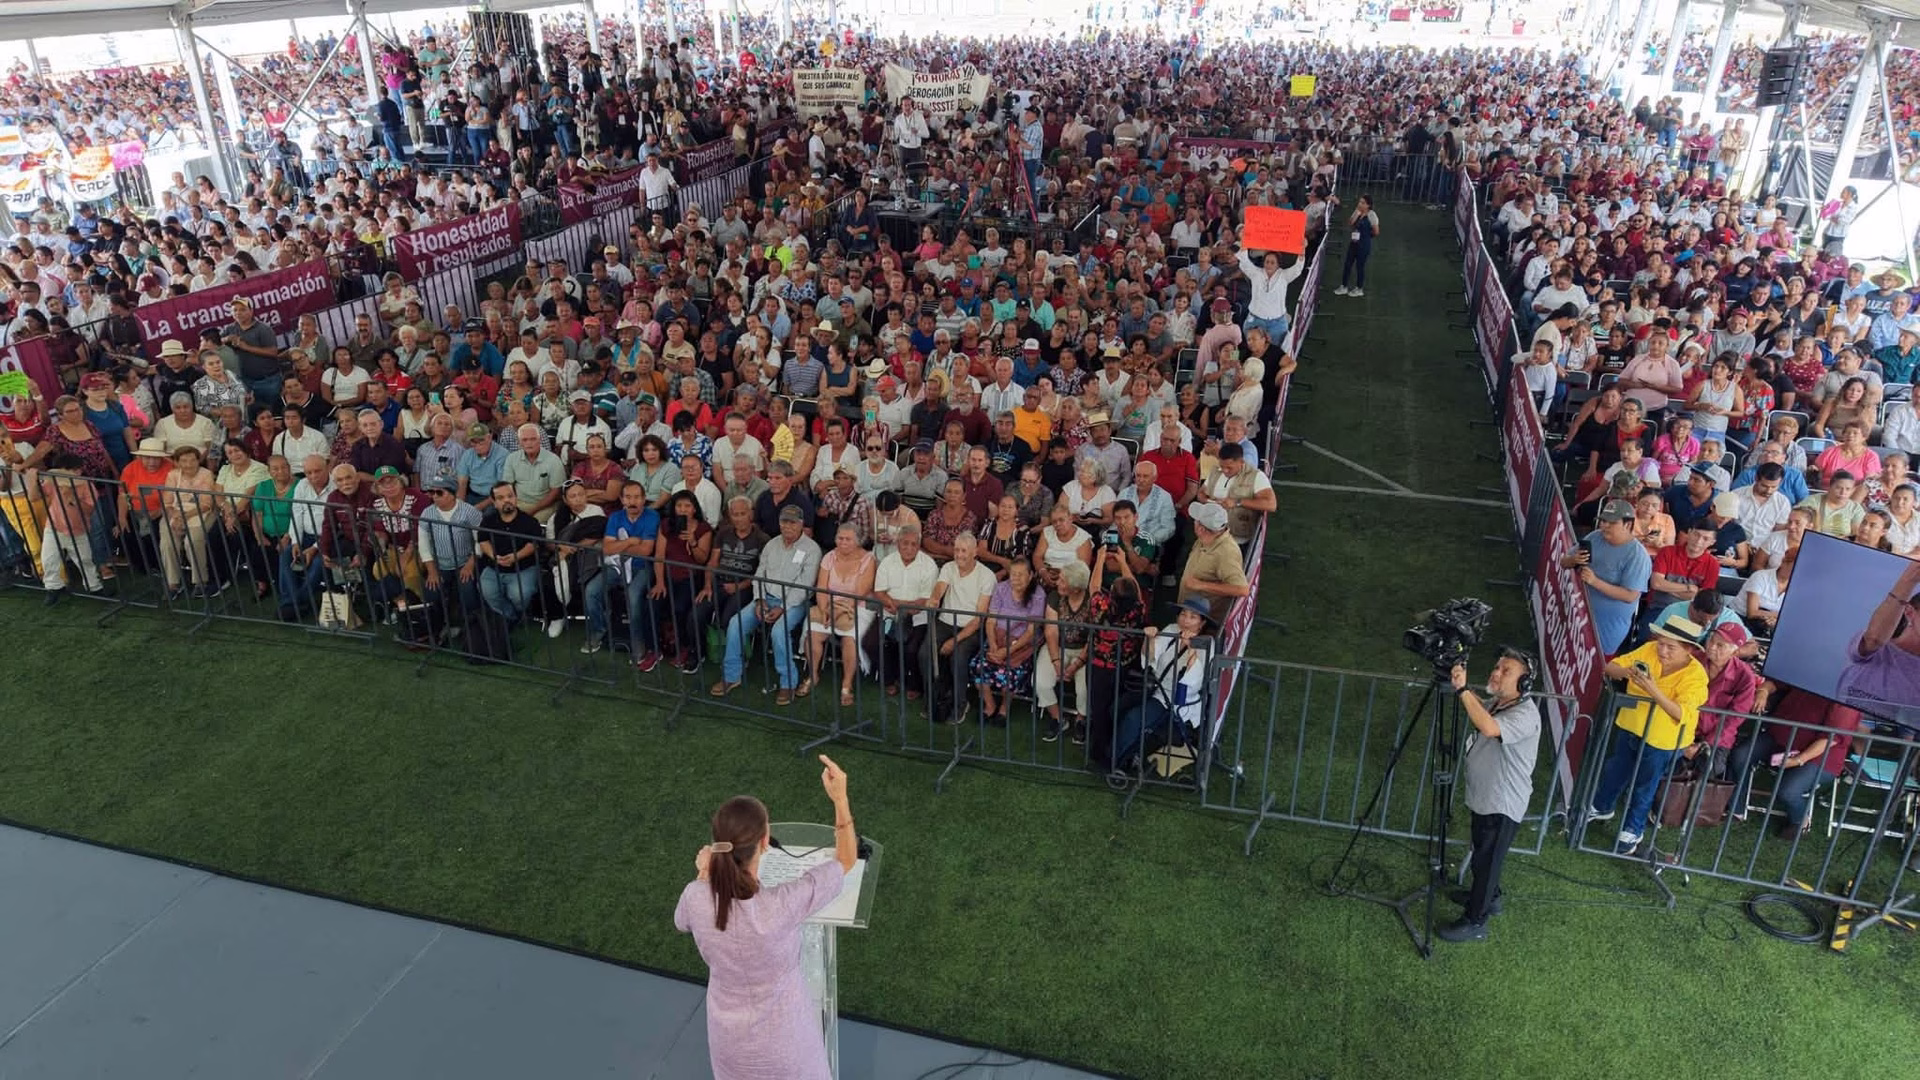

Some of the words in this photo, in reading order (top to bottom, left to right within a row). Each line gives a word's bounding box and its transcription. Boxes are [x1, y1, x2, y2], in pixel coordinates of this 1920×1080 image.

[802, 82, 813, 90] QUE
[814, 82, 825, 90] SUS
[907, 84, 955, 99] DEROGACIÓN
[957, 82, 971, 95] DEL
[560, 194, 574, 209] La
[409, 207, 510, 256] Honestidad
[416, 260, 427, 278] y
[432, 233, 512, 272] resultados
[142, 318, 173, 341] La
